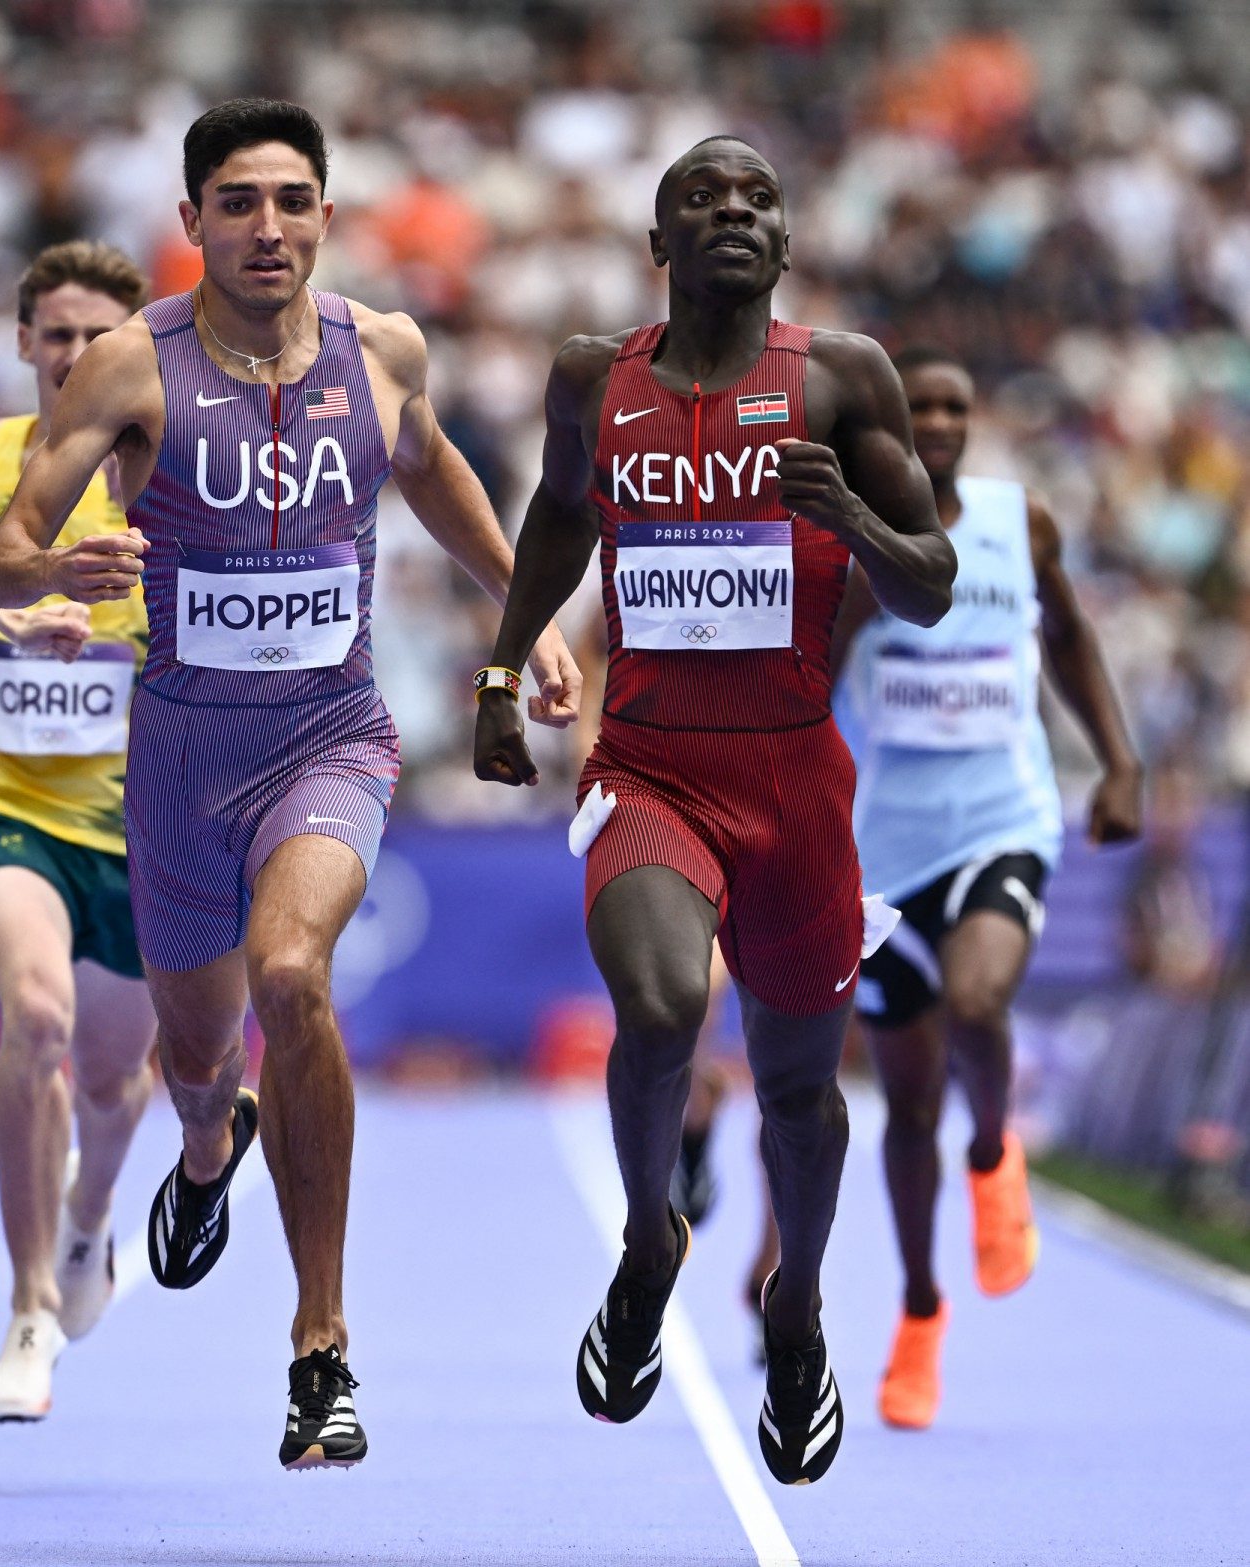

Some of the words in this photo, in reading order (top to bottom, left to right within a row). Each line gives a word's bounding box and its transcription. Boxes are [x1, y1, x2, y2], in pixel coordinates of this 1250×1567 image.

[196, 436, 354, 512] USA
[612, 445, 782, 505] KENYA
[655, 528, 697, 540] PARIS
[702, 529, 744, 540] 2024
[225, 556, 270, 568] PARIS
[276, 554, 315, 567] 2024
[188, 587, 352, 631] HOPPEL
[619, 568, 787, 609] WANYONYI
